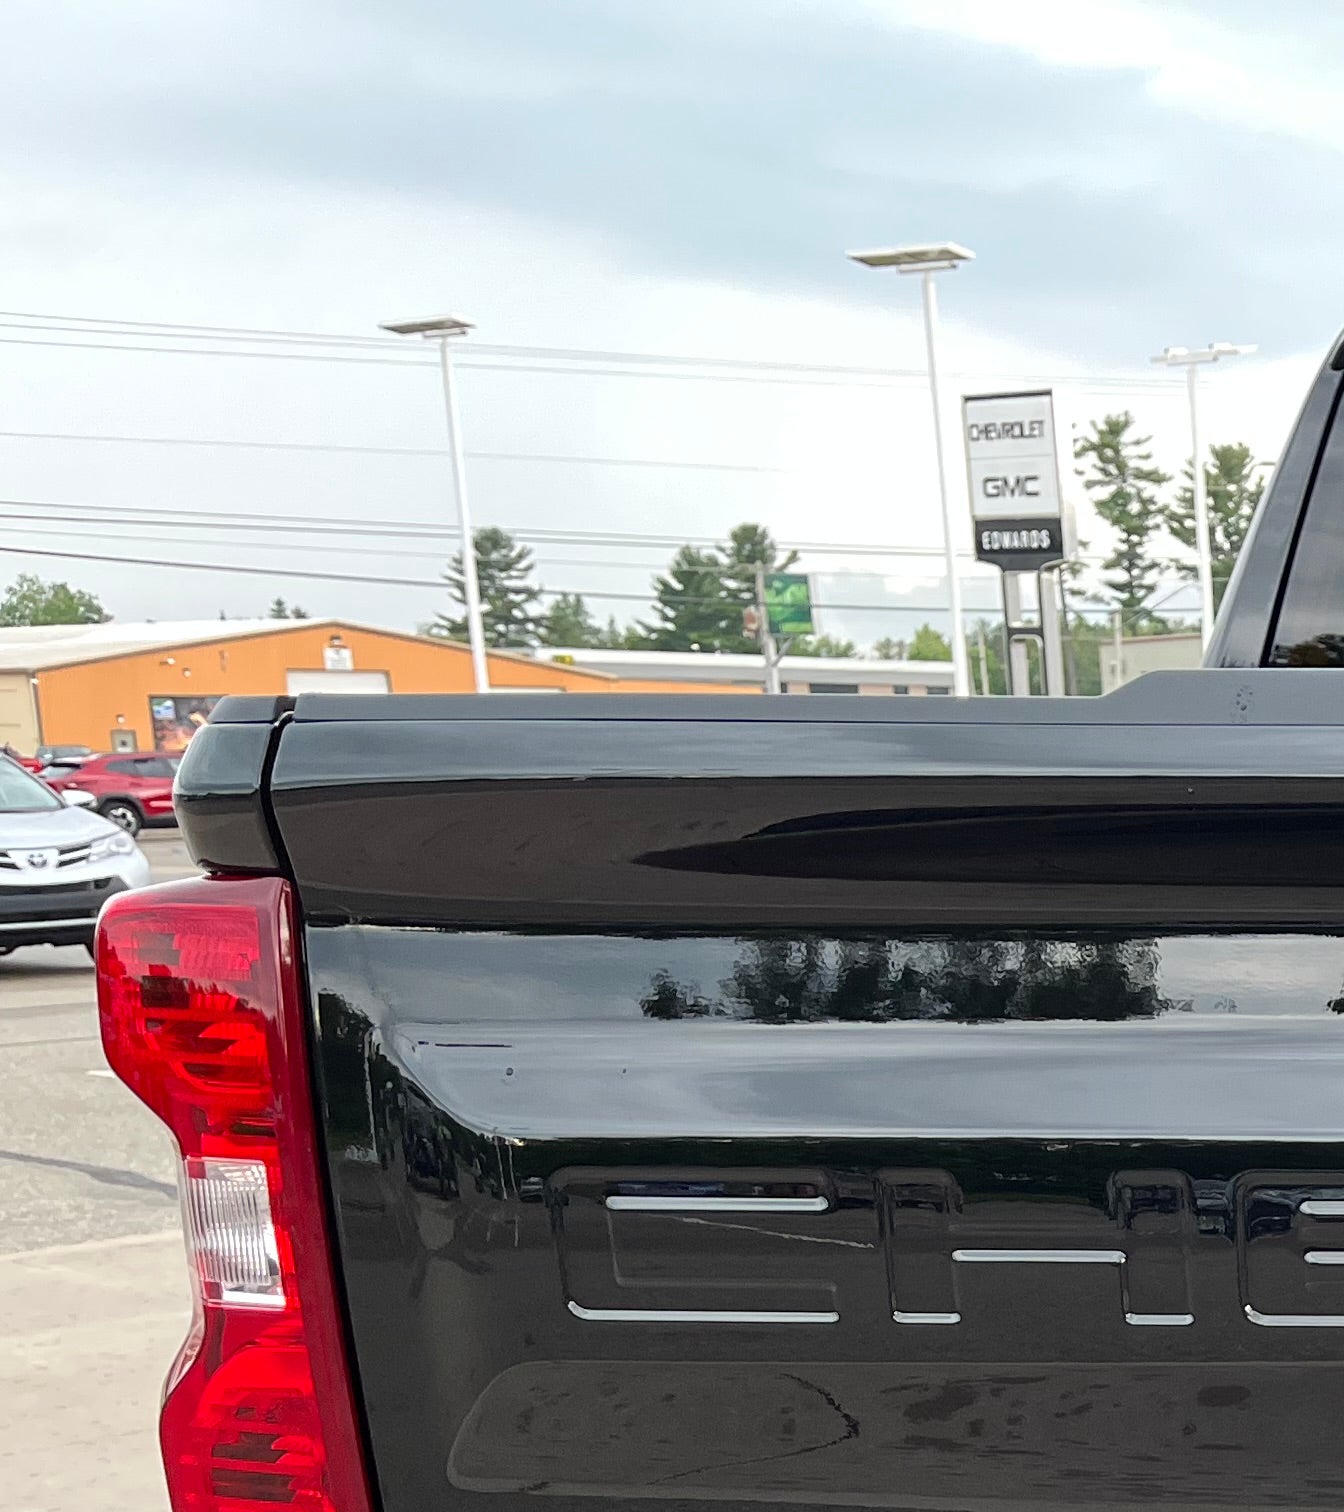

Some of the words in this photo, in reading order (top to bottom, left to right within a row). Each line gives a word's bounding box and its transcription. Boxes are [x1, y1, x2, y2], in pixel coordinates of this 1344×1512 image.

[969, 421, 1045, 442] CHEVROLET
[983, 475, 1040, 497] GMC
[981, 529, 1051, 550] EDWARDS
